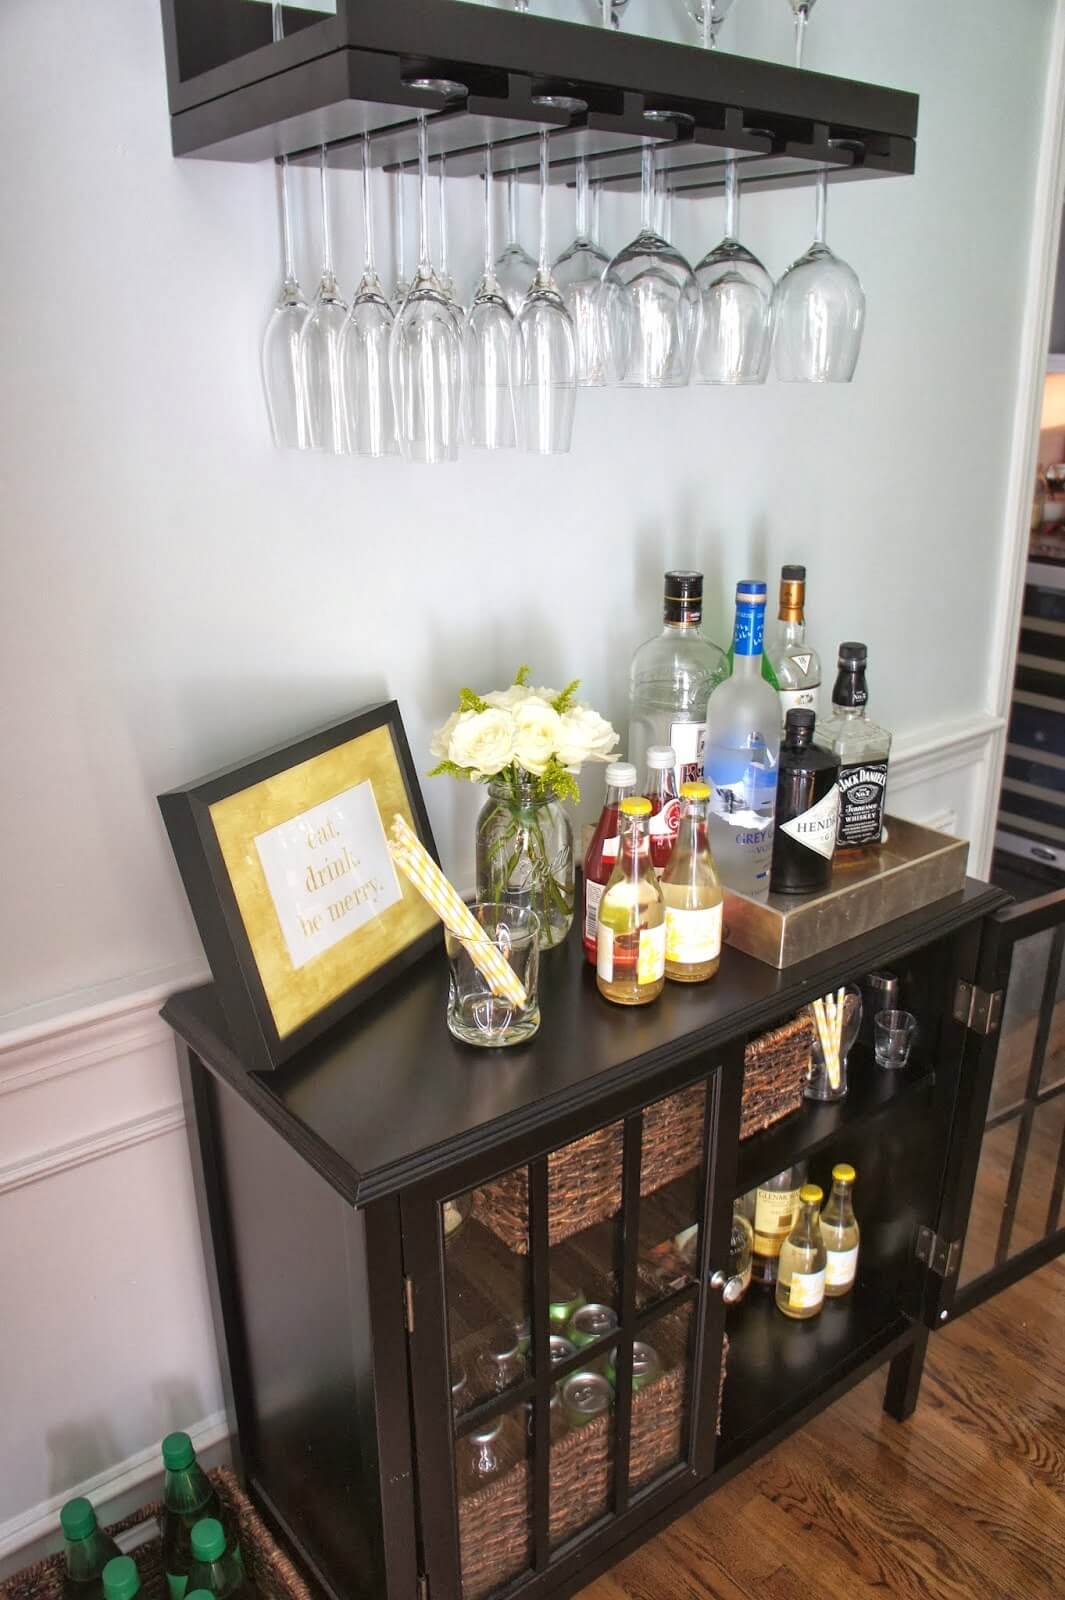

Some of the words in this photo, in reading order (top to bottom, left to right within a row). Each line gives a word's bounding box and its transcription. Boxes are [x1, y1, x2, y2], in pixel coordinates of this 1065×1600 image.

[839, 774, 859, 792] JACK
[846, 812, 876, 822] WHISKEY
[736, 831, 767, 845] GREY
[300, 914, 321, 937] be
